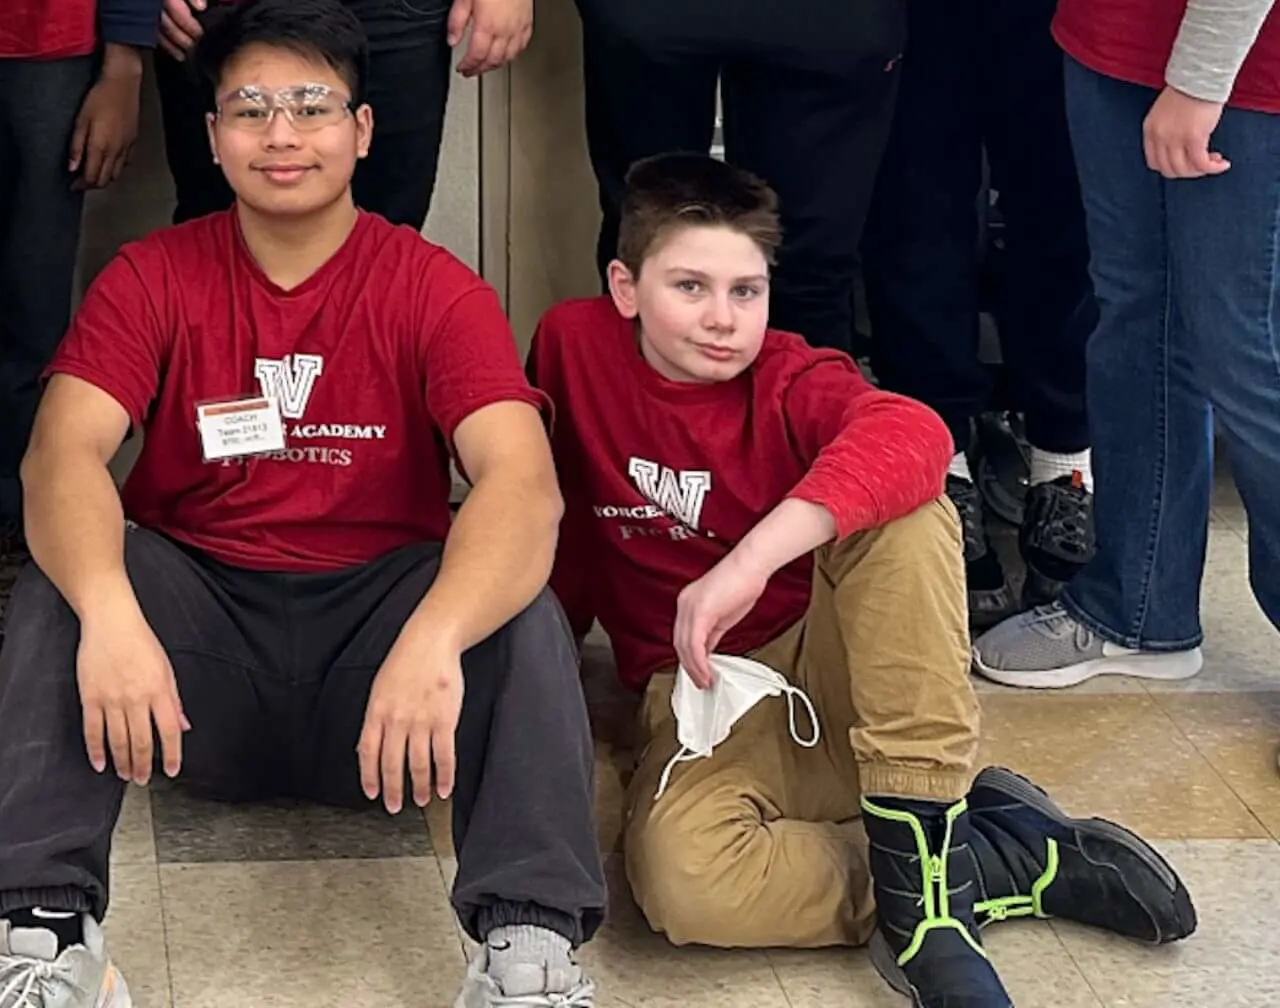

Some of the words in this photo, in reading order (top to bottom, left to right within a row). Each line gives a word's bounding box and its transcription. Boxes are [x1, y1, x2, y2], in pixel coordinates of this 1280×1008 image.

[254, 353, 324, 419] W
[223, 414, 257, 425] COACH
[290, 423, 386, 439] ACADEMY
[255, 446, 352, 466] BOTICS
[628, 456, 711, 532] W
